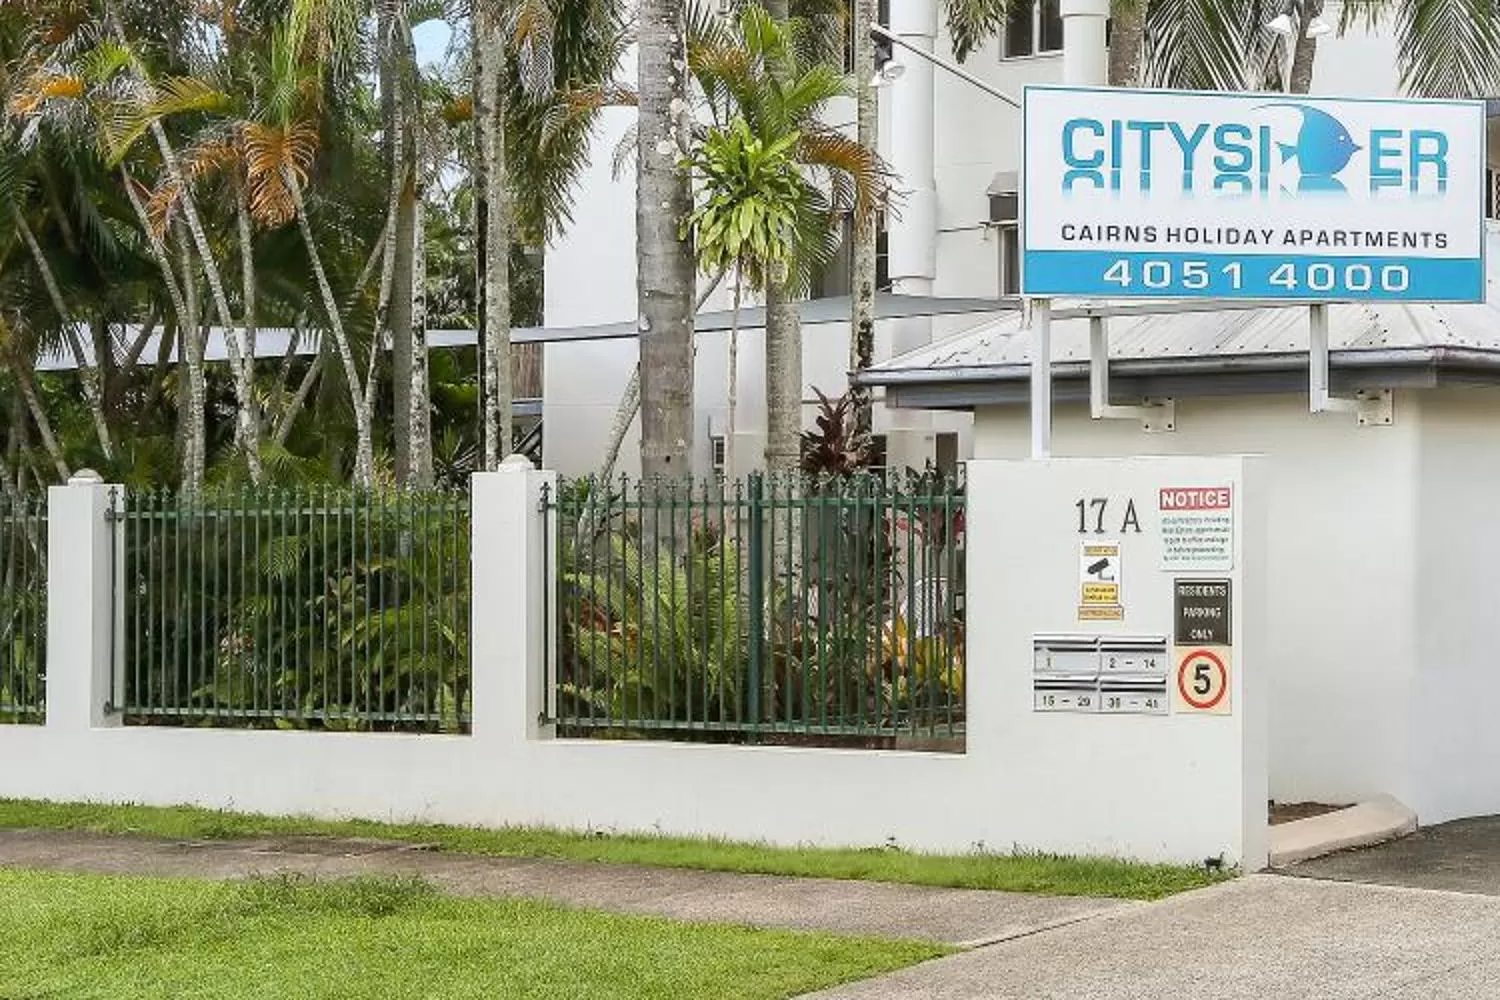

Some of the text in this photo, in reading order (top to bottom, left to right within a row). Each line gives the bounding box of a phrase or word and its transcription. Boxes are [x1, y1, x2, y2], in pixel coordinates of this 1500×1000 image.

[1061, 224, 1448, 249] CAIRNS HOLIDAY APARTMENTS
[1103, 258, 1410, 292] 4051 4000
[1161, 490, 1229, 507] NOTICE
[1075, 498, 1142, 534] 17 A
[1178, 585, 1227, 597] RESIDENTS
[1183, 607, 1221, 619] PARKING
[1190, 628, 1214, 640] ONLY
[1193, 663, 1212, 695] 5
